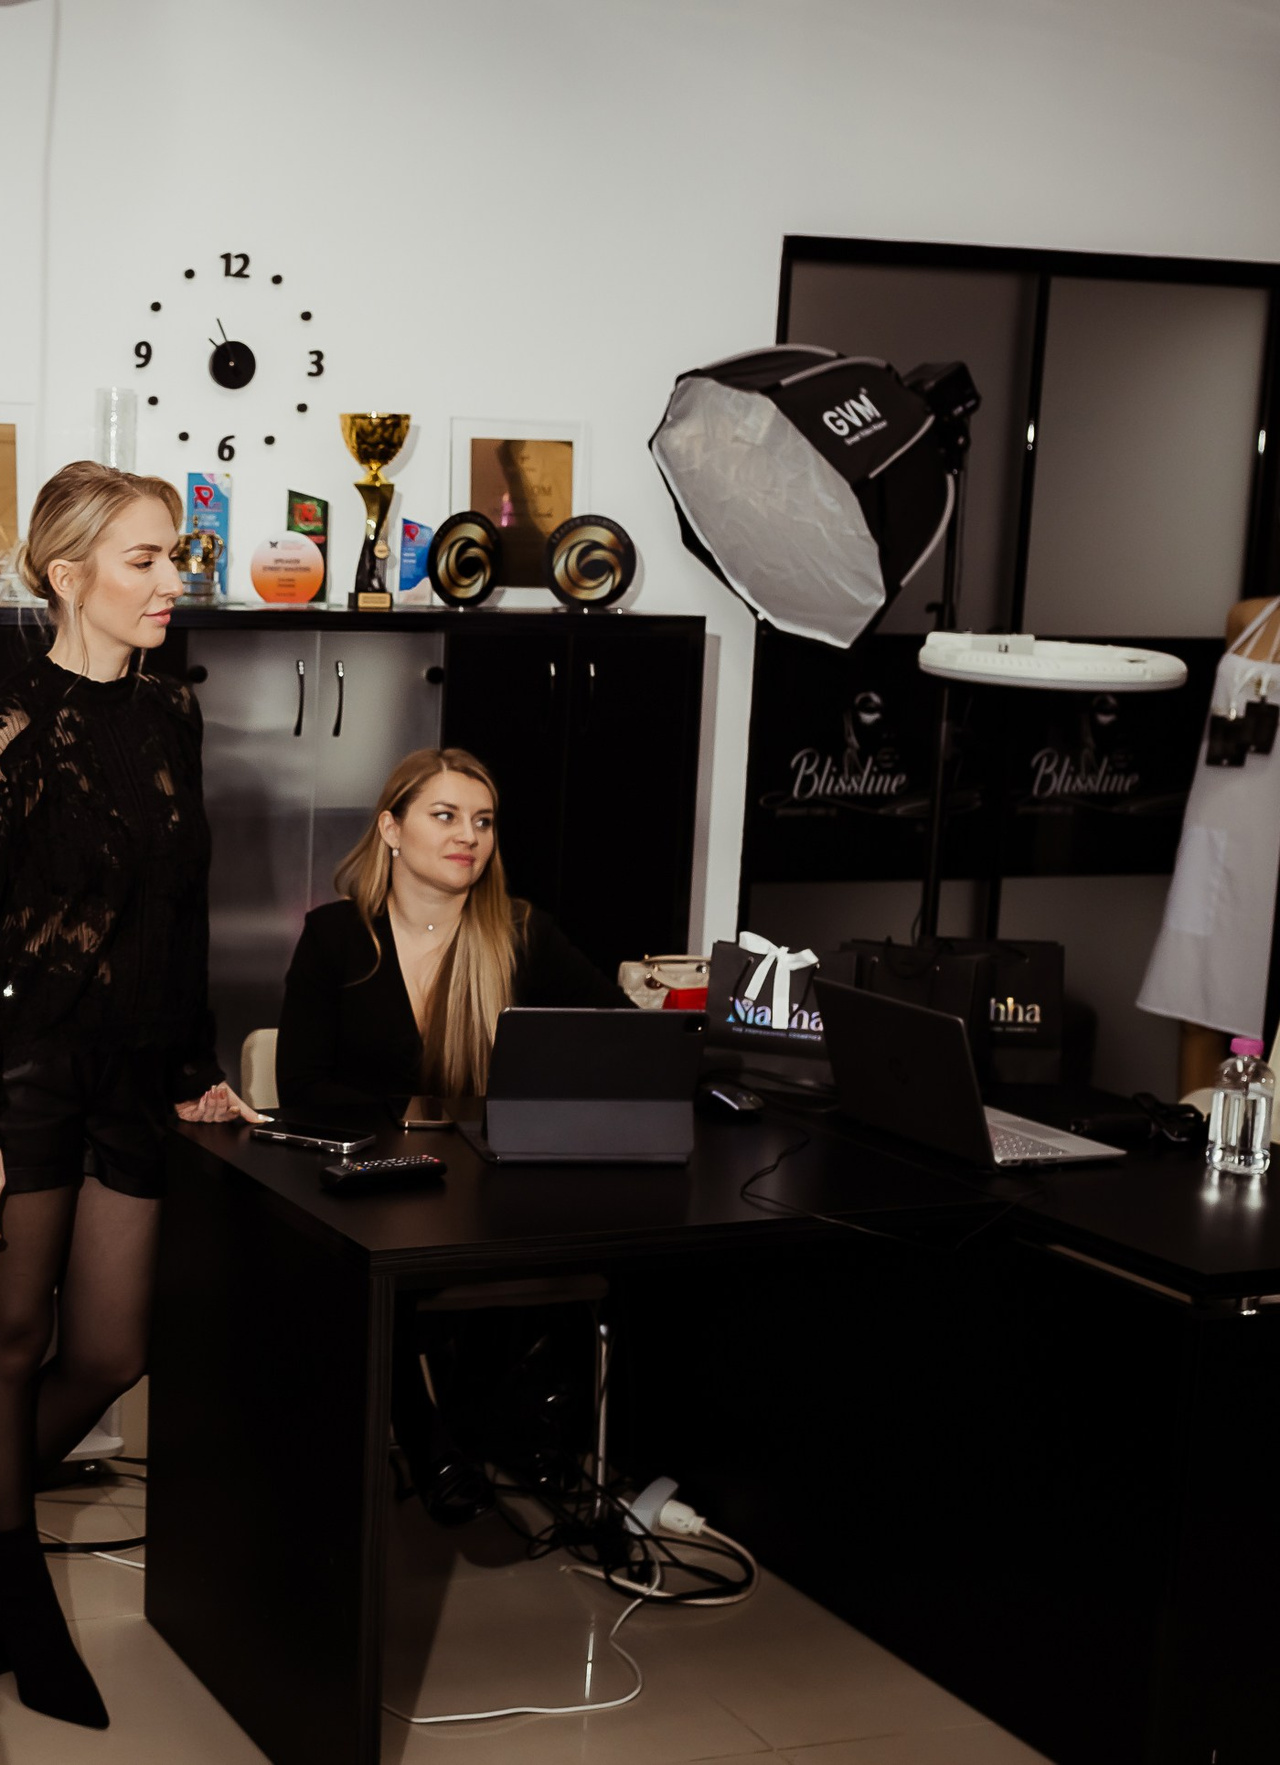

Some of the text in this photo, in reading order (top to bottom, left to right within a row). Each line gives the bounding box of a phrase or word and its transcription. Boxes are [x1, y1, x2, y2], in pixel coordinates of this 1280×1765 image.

[220, 253, 250, 278] 12
[135, 341, 152, 368] 9
[307, 350, 324, 376] 3
[823, 393, 882, 436] GVM
[217, 435, 235, 461] 6
[790, 747, 907, 800] Blissline
[1031, 746, 1139, 800] Blissline
[725, 995, 824, 1032] Maha
[990, 997, 1041, 1024] hha
